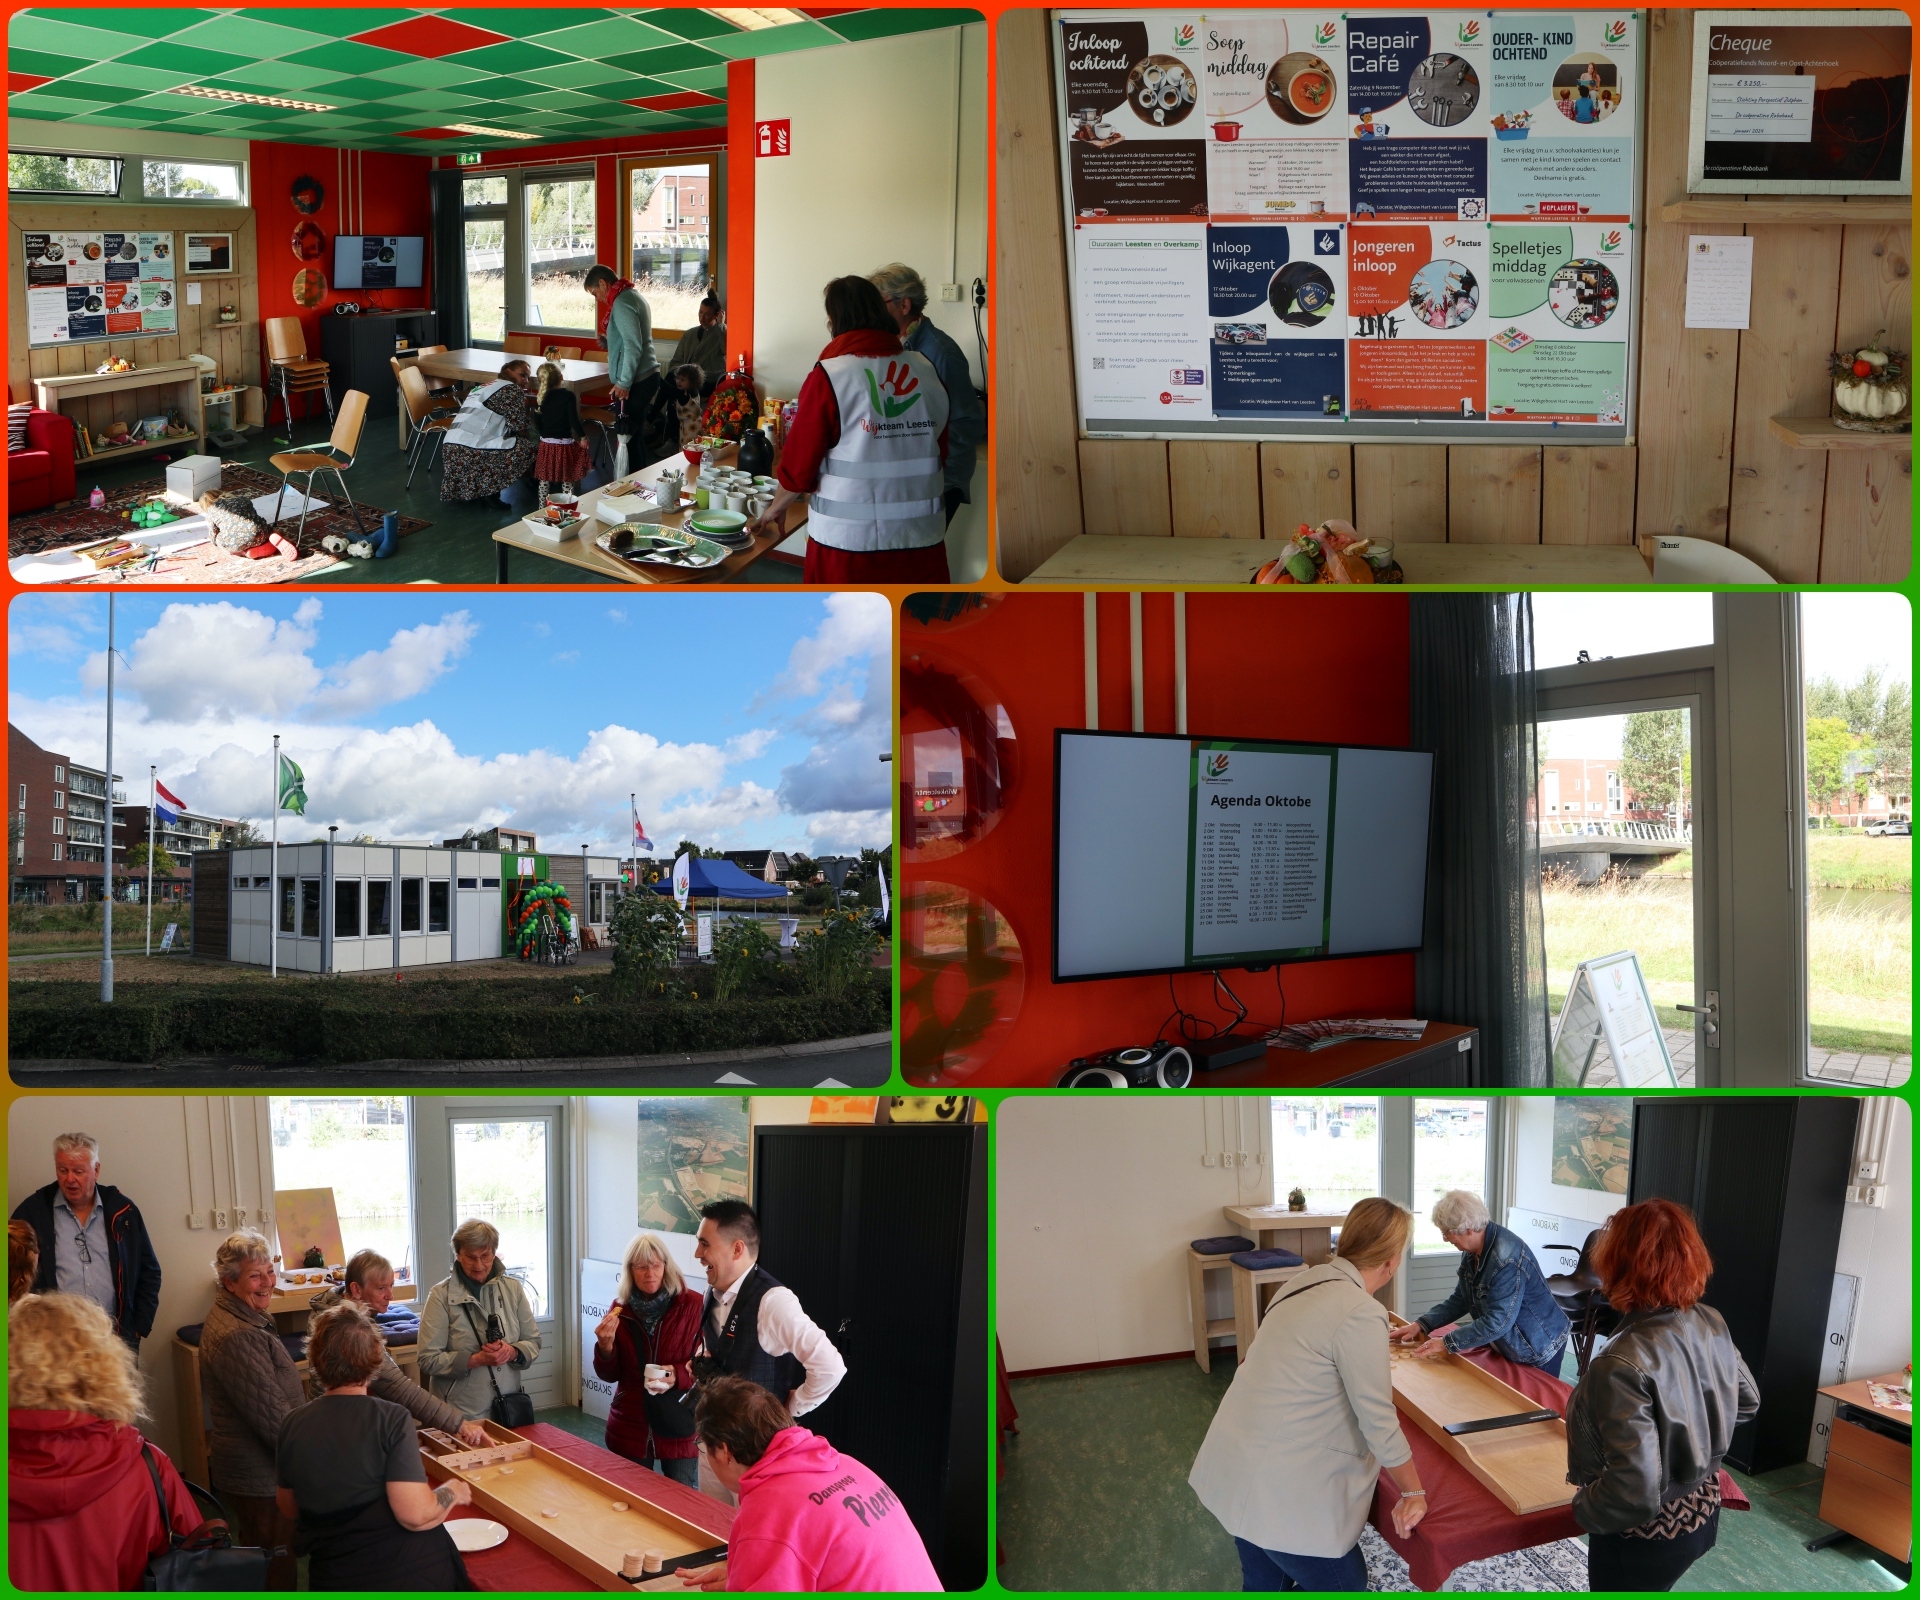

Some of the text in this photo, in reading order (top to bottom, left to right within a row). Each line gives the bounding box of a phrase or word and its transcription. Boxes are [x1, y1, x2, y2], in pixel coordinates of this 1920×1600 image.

[1068, 31, 1122, 52] Inloop
[1207, 31, 1245, 54] Soep
[1350, 31, 1419, 53] Repair
[1493, 32, 1573, 46] OUDER- KIND
[1710, 34, 1772, 54] Cheque
[1069, 54, 1129, 70] ochtend
[1493, 47, 1548, 60] OCHTEND
[1208, 54, 1268, 80] middag
[1350, 54, 1399, 72] Café
[1212, 241, 1251, 256] Inloop
[1353, 240, 1414, 256] Jongeren
[1492, 241, 1562, 258] Spelletjes
[1213, 259, 1275, 273] Wijkagent
[1353, 258, 1396, 275] inloop
[1492, 259, 1546, 276] middag
[861, 419, 904, 436] Wijkteam
[1211, 795, 1311, 809] Agenda Oktobe
[1532, 1218, 1559, 1232] SKYBOND
[809, 1475, 857, 1505] Dansgroep
